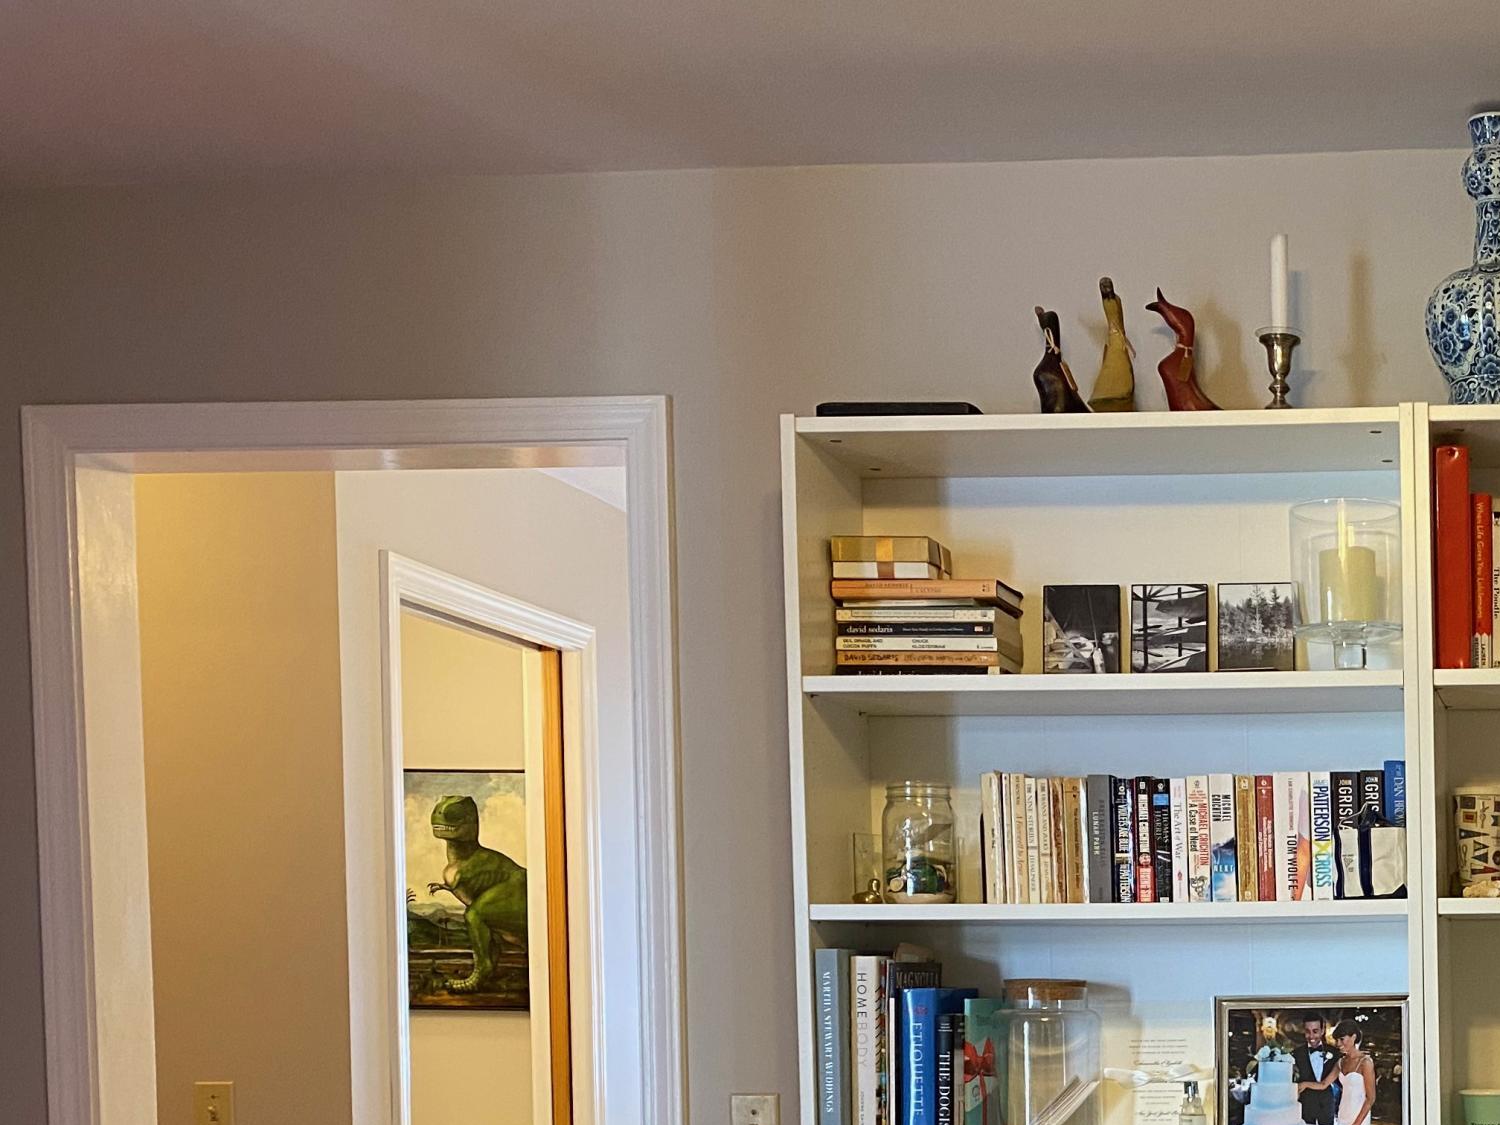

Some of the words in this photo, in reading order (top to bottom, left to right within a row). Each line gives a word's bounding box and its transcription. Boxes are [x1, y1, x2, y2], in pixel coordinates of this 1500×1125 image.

[1493, 566, 1500, 586] The
[1493, 587, 1500, 620] Poodle
[1393, 777, 1404, 797] DAN
[1189, 809, 1199, 826] Case
[1199, 803, 1209, 834] MICHAEL
[1211, 794, 1222, 822] CRICHTON
[1222, 794, 1231, 822] MICHAEL
[1314, 785, 1329, 842] PATTERSON
[1337, 787, 1352, 831] GRISHA
[1189, 835, 1199, 852] Need
[1199, 836, 1209, 866] CRICHTON
[1287, 834, 1298, 854] TOM
[1119, 869, 1130, 902] PATTERSON
[1287, 857, 1298, 890] WOLFE
[1316, 854, 1330, 888] CROSS
[822, 971, 833, 1012] MARTHA
[822, 1014, 833, 1058] STEWART
[857, 972, 868, 1068] HOMEBODY
[912, 1022, 924, 1116] ETIQUETTE
[939, 1051, 951, 1081] THE
[822, 1062, 833, 1113] WEDDINGS
